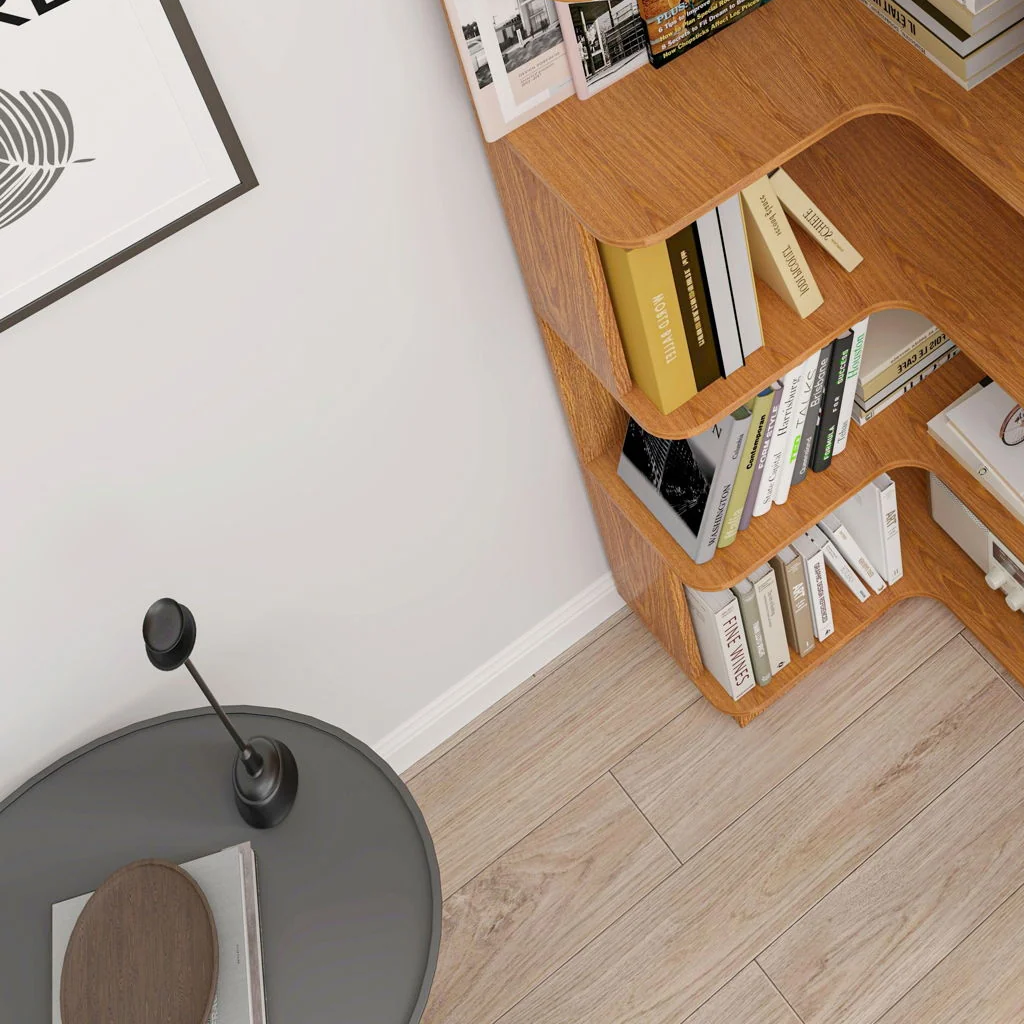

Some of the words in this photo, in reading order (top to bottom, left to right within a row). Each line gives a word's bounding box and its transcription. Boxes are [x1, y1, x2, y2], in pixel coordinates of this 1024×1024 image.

[657, 1, 688, 24] PLUS:
[665, 20, 678, 31] Tips
[686, 0, 711, 17] Improve
[668, 30, 691, 47] Secrets
[699, 18, 708, 28] Fit
[709, 7, 729, 22] Dream
[729, 2, 736, 10] to
[697, 4, 718, 20] Special
[883, 4, 907, 30] ÉTAIT
[909, 22, 917, 36] IL
[662, 48, 677, 59] How
[677, 29, 710, 50] Chopsticks
[711, 16, 729, 30] Affect
[847, 333, 865, 381] Houston
[811, 357, 829, 408] Brisbane
[777, 375, 802, 438] Harrisburg
[789, 435, 801, 465] TED
[795, 368, 817, 430] TALKS
[758, 442, 770, 470] FORM
[766, 405, 779, 442] STYLE
[823, 424, 836, 461] FORMULA
[832, 396, 841, 413] FOR
[708, 483, 731, 547] WASHINGTON
[886, 510, 897, 528] ART
[792, 582, 805, 601] ART
[723, 616, 741, 648] FINE
[730, 644, 750, 687] WINES
